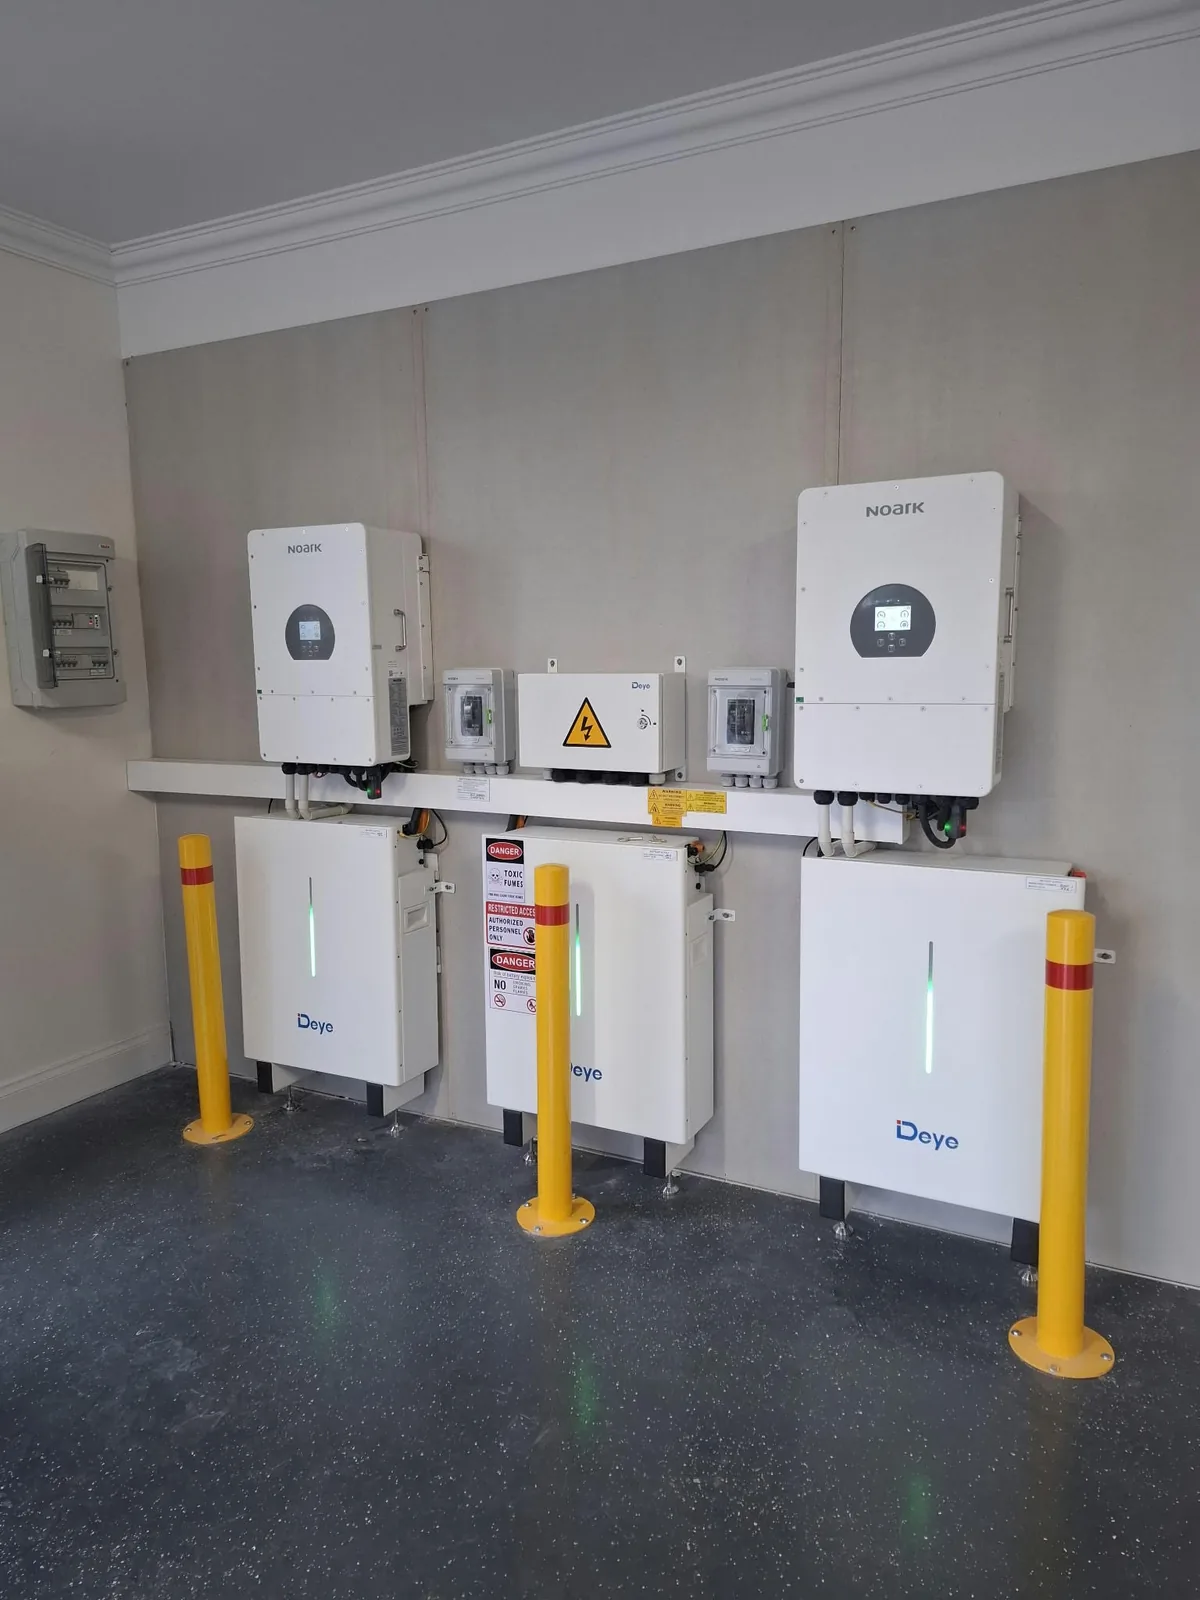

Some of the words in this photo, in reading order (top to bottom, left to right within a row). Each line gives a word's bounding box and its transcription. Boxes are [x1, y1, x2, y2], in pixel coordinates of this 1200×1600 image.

[490, 846, 520, 856] DANGER
[504, 869, 523, 879] TOXIC
[504, 879, 524, 888] FUMES
[488, 903, 518, 915] RESTRICTED
[519, 908, 536, 917] ACCES
[488, 916, 524, 927] AUTHORIZED
[488, 925, 521, 936] PERSONNEL
[489, 933, 504, 941] ONLY
[496, 955, 536, 969] DANGER
[494, 979, 507, 991] NO
[297, 1012, 334, 1035] Deye
[570, 1062, 603, 1082] eye
[896, 1119, 959, 1151] Deye
